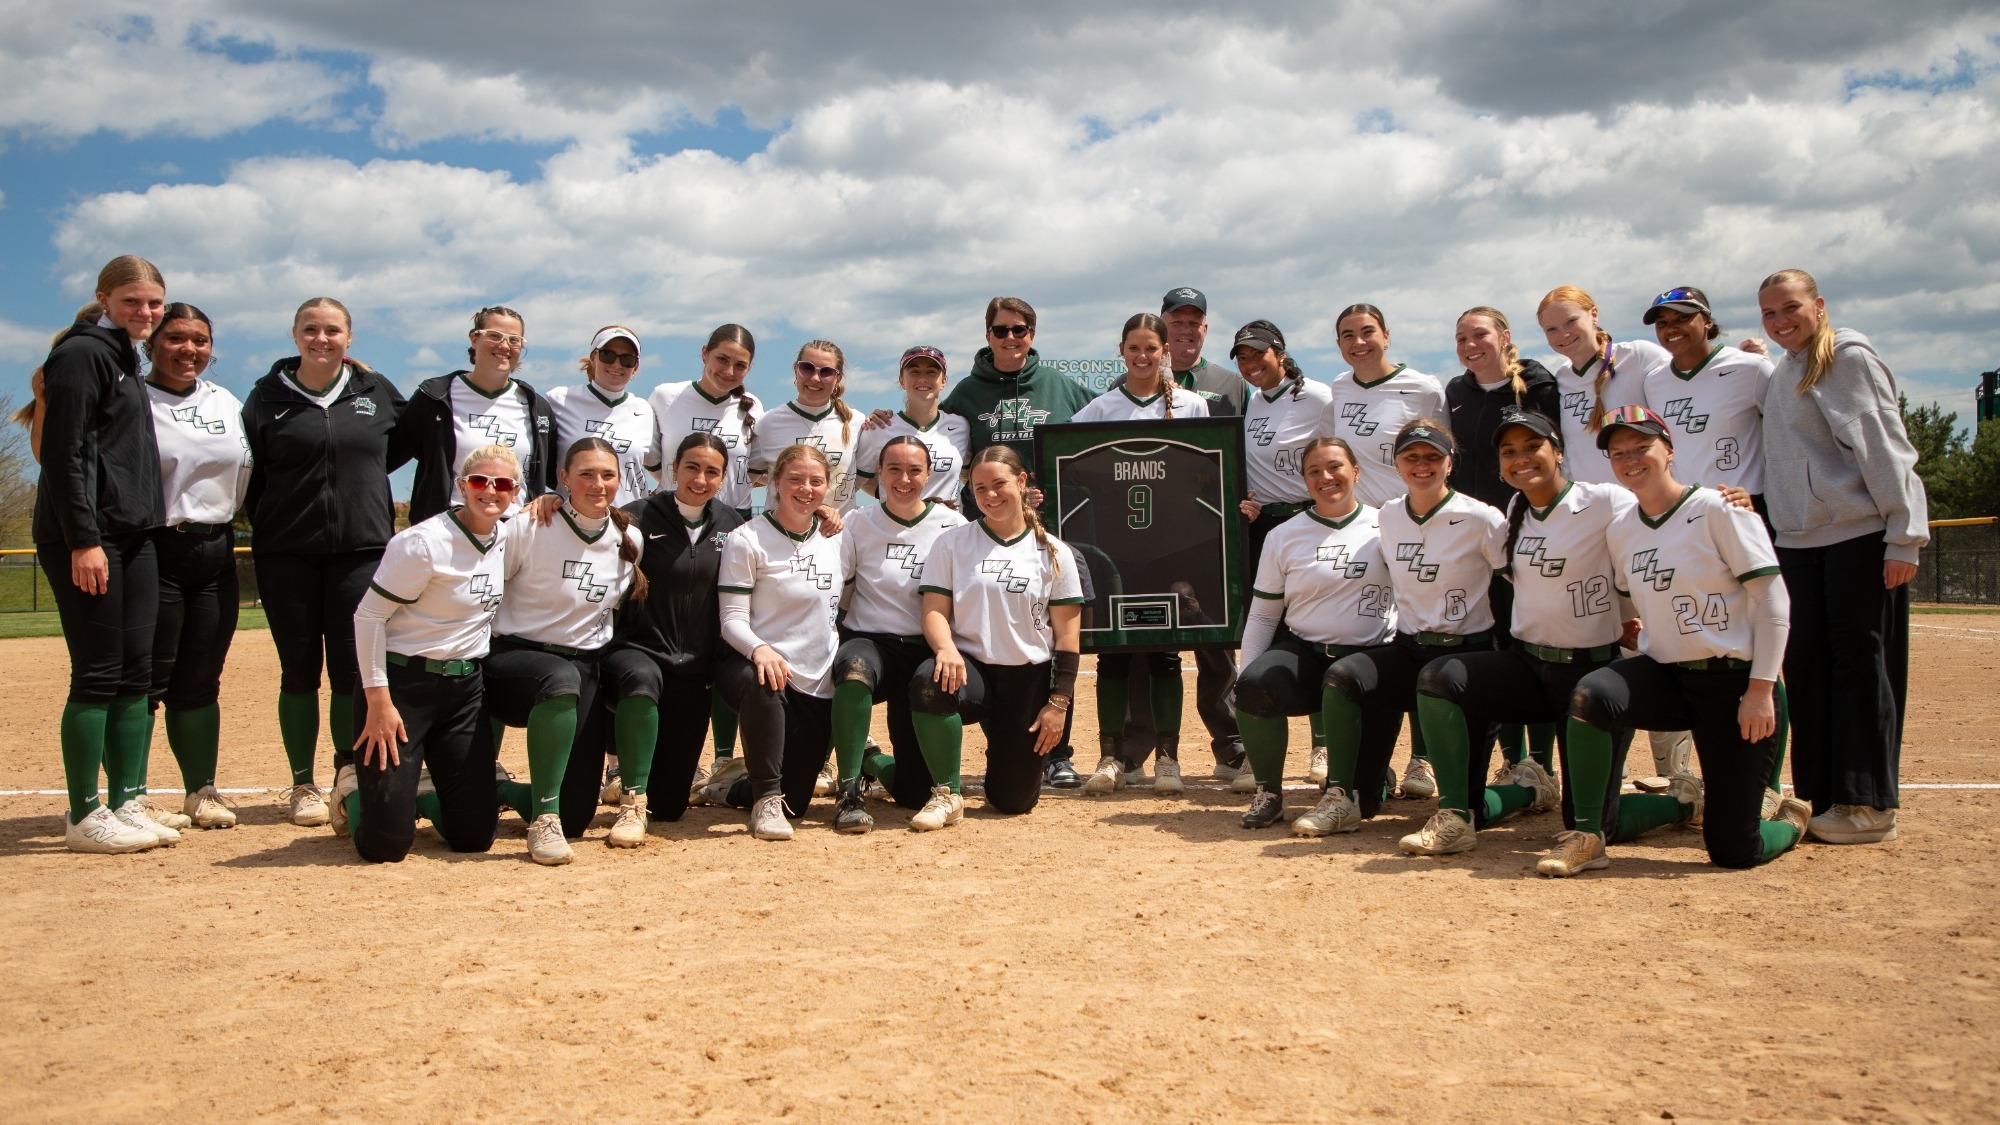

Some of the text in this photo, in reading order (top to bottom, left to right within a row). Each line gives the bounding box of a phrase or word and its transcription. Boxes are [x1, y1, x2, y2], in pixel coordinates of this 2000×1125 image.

[170, 406, 226, 434] WLC
[469, 414, 518, 448] WLC
[1247, 416, 1276, 447] WLC
[1340, 402, 1379, 436] WLC
[1663, 397, 1710, 434] WLC
[585, 419, 633, 454] WLC
[1715, 436, 1740, 471] 3
[1114, 460, 1166, 481] BRANDS
[1127, 484, 1153, 530] 9
[789, 554, 832, 590] WLC
[1316, 544, 1369, 580] WLC
[1395, 542, 1441, 583] WLC
[1516, 536, 1567, 578] WLC
[1631, 547, 1675, 592] WLC
[470, 573, 503, 612] WLC
[562, 559, 609, 603] WLC
[981, 559, 1030, 594] WLC
[1357, 583, 1393, 620] 29
[1444, 588, 1468, 622] 6
[1566, 574, 1611, 618] 12
[1671, 592, 1729, 635] 24
